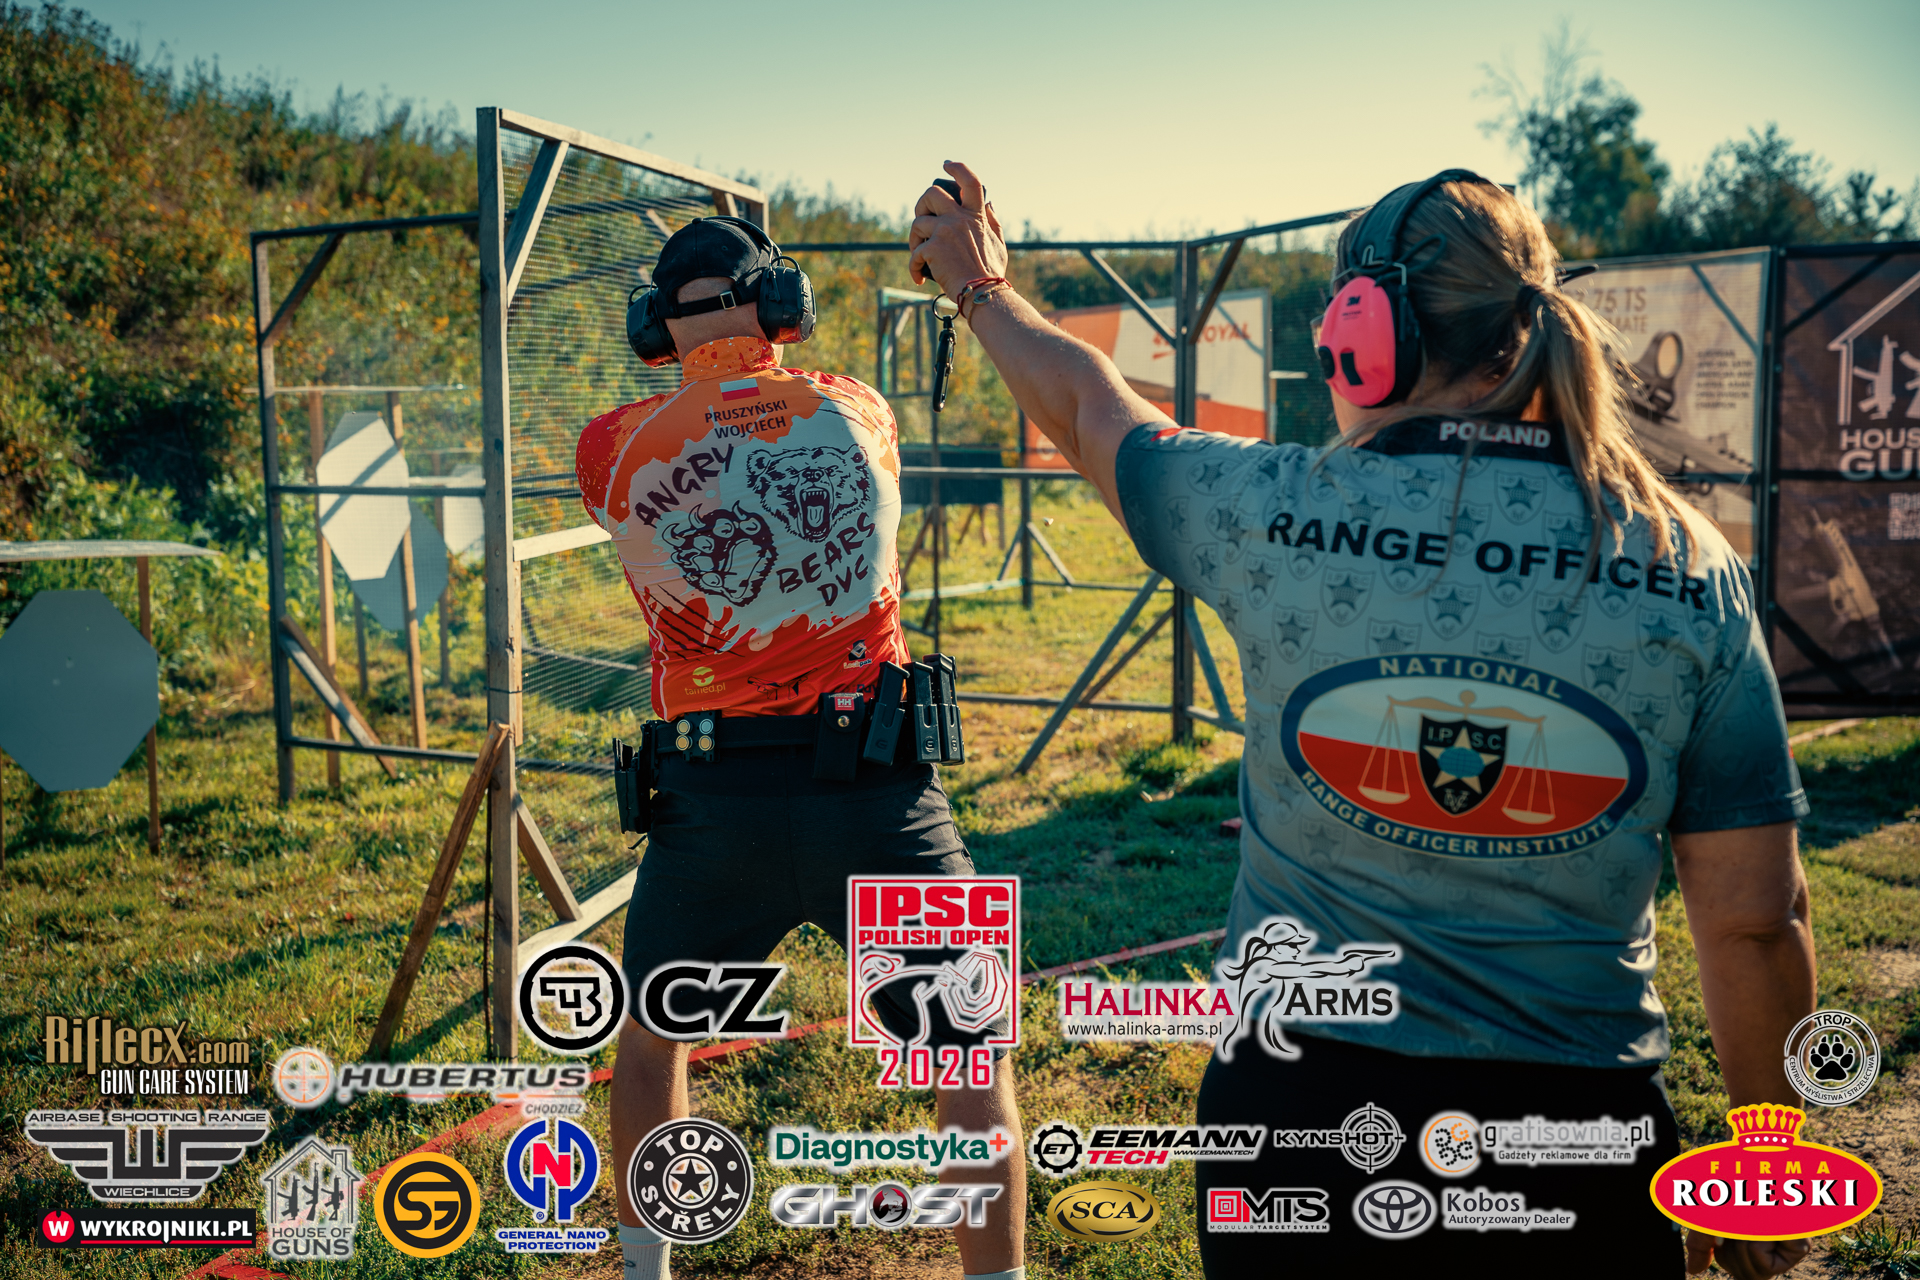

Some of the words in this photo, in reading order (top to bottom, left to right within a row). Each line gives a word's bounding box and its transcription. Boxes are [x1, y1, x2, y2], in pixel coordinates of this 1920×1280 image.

[1197, 322, 1251, 344] OYAL
[705, 400, 788, 423] PRUSZYŃSKI
[714, 416, 787, 439] WOJCIECH
[1439, 421, 1551, 448] POLAND
[1840, 448, 1920, 481] GU
[634, 443, 734, 529] ANGRY
[776, 512, 876, 594] BEARS
[1268, 511, 1449, 569] RANGE
[1476, 540, 1707, 611] OFFICER
[817, 554, 868, 607] DVC
[684, 682, 726, 696] tamed.pl
[1379, 657, 1562, 699] NATIONAL
[1302, 770, 1366, 829] RANGE
[1374, 822, 1479, 854] OFFICER
[1488, 814, 1614, 855] INSTITUTE
